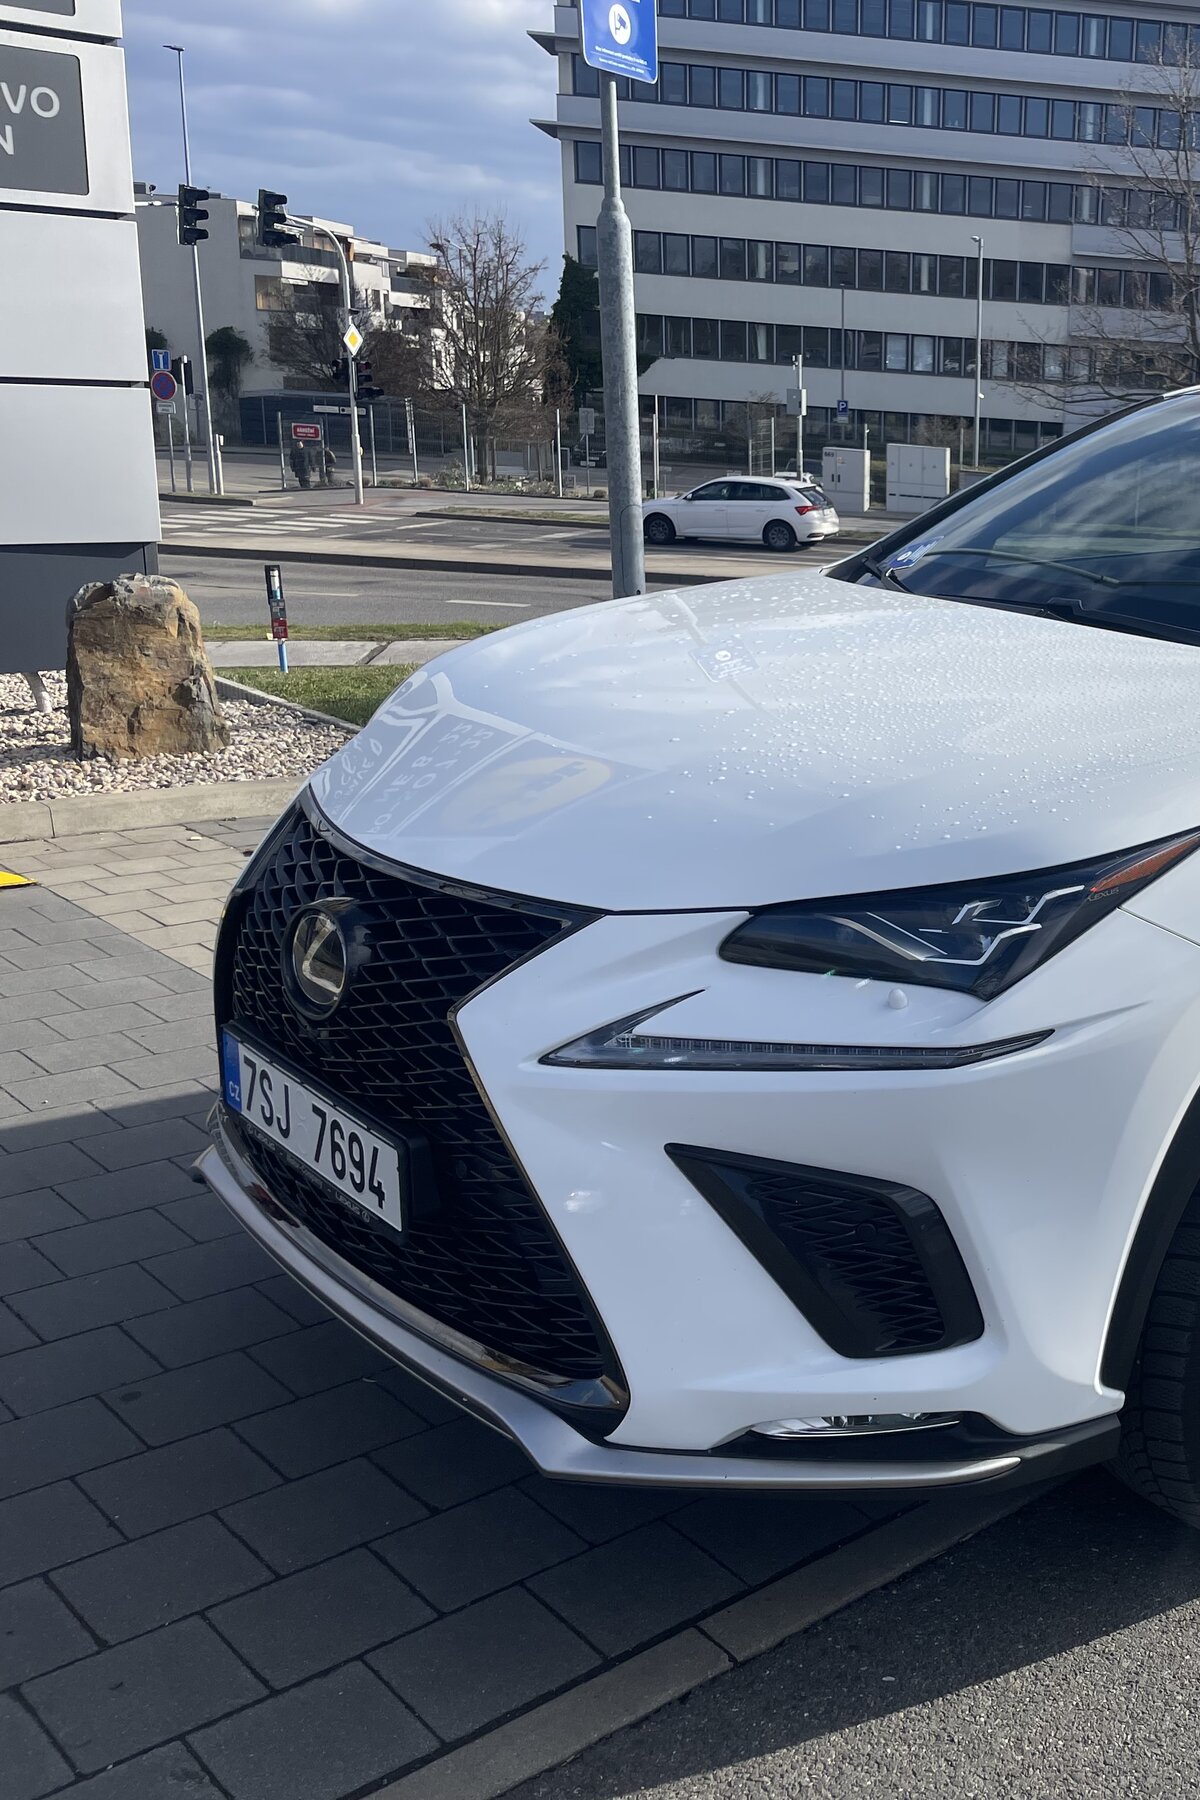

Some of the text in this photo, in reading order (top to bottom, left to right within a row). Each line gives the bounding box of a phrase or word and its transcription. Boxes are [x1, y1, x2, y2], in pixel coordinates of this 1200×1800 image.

[0, 82, 60, 118] VO
[840, 402, 846, 411] P
[1088, 887, 1119, 902] LEXUS
[229, 1081, 241, 1101] CZ
[243, 1054, 386, 1210] 7SJ 7694
